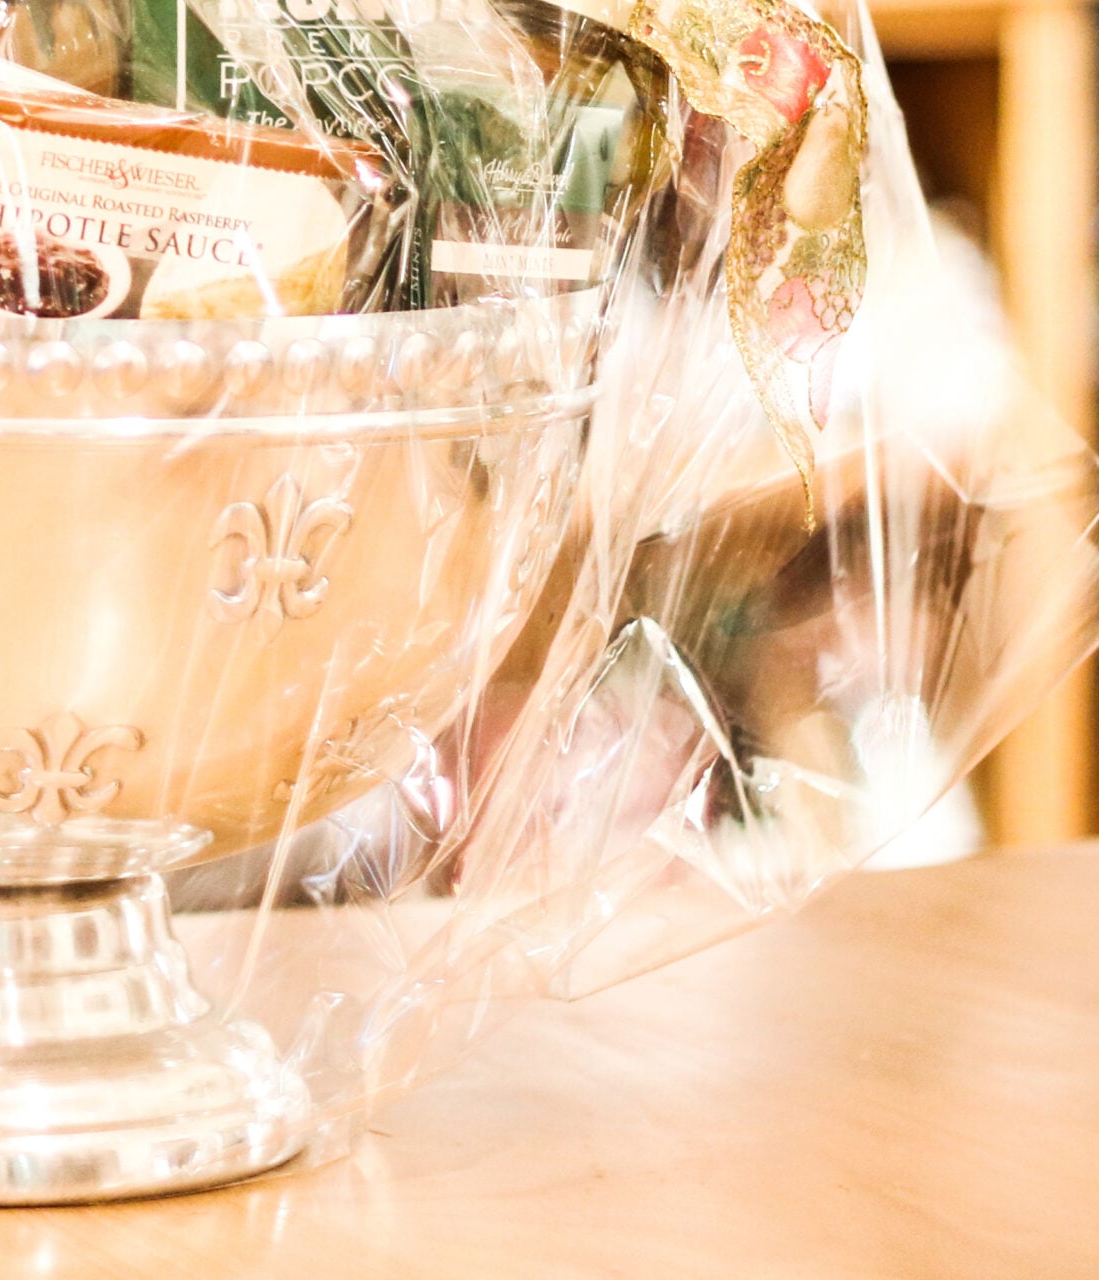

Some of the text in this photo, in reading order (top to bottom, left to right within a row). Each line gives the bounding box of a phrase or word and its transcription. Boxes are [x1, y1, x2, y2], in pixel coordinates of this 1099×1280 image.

[248, 111, 287, 129] The
[92, 194, 164, 219] ROASTED
[168, 206, 254, 233] RASPBERRY
